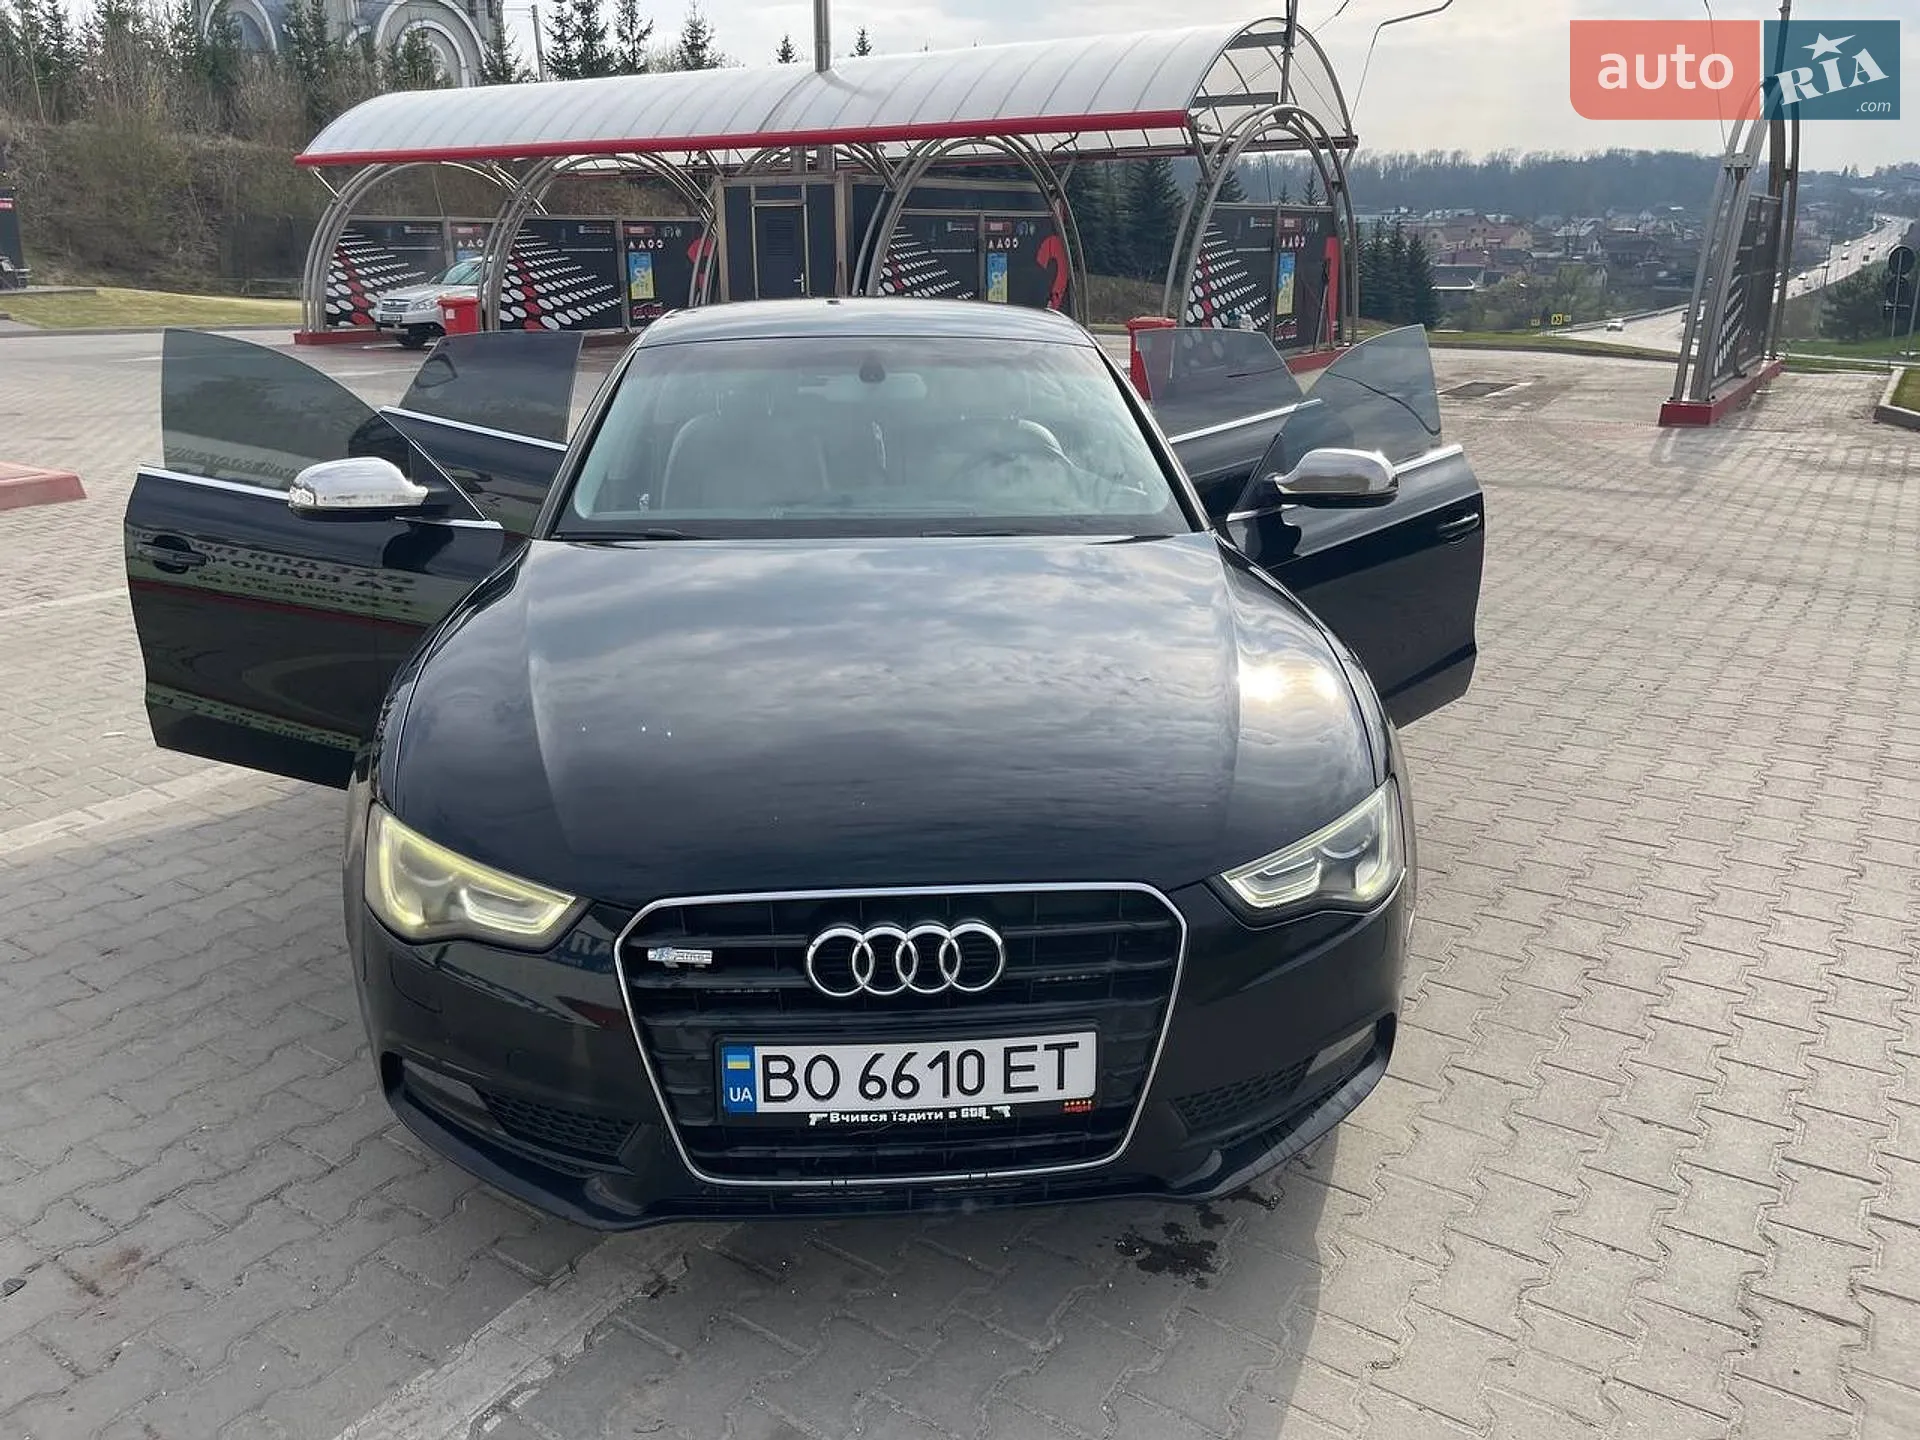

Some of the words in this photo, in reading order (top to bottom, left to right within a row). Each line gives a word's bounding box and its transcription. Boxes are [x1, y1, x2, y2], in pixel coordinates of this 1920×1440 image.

[762, 1054, 840, 1103] BO
[859, 1049, 985, 1100] 6610
[1004, 1042, 1079, 1094] ET
[729, 1087, 753, 1102] UA
[829, 1112, 888, 1123] Вчився
[891, 1110, 944, 1123] їздити
[948, 1111, 958, 1119] в
